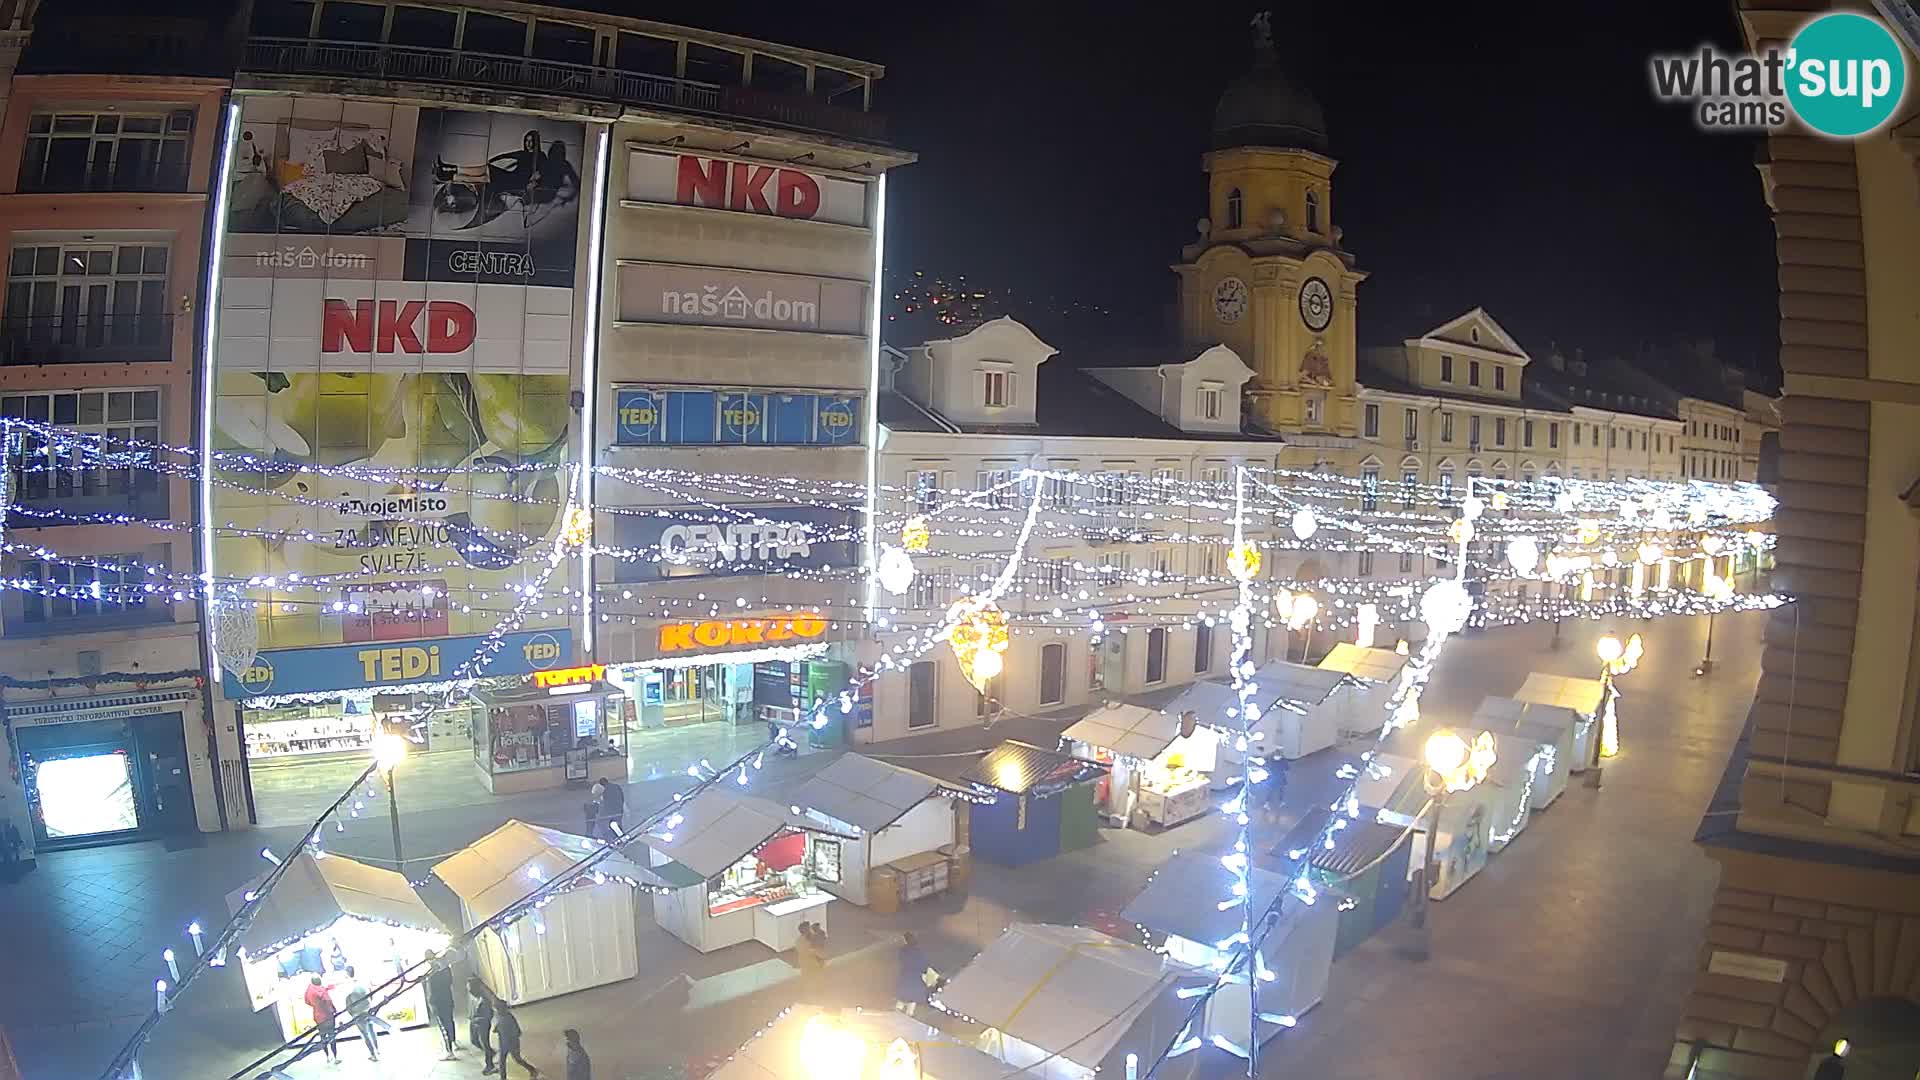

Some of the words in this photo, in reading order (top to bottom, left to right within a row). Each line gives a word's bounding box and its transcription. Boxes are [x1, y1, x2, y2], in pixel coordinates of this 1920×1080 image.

[677, 154, 821, 219] NKD
[255, 244, 296, 269] naš
[320, 247, 367, 269] dom
[448, 249, 536, 276] CENTRA
[661, 284, 719, 316] naš
[753, 290, 817, 323] dom
[321, 297, 477, 353] NKD
[619, 408, 658, 425] TEDi
[723, 408, 760, 426] TEDi
[820, 411, 853, 427] TEDi
[340, 496, 447, 516] #TvojeMisto
[659, 520, 811, 563] CENTRA
[657, 610, 827, 652] KORZO
[359, 645, 441, 683] TEDi
[523, 643, 561, 660] TEDi
[245, 665, 274, 684] EDi
[534, 664, 607, 688] TOMMY
